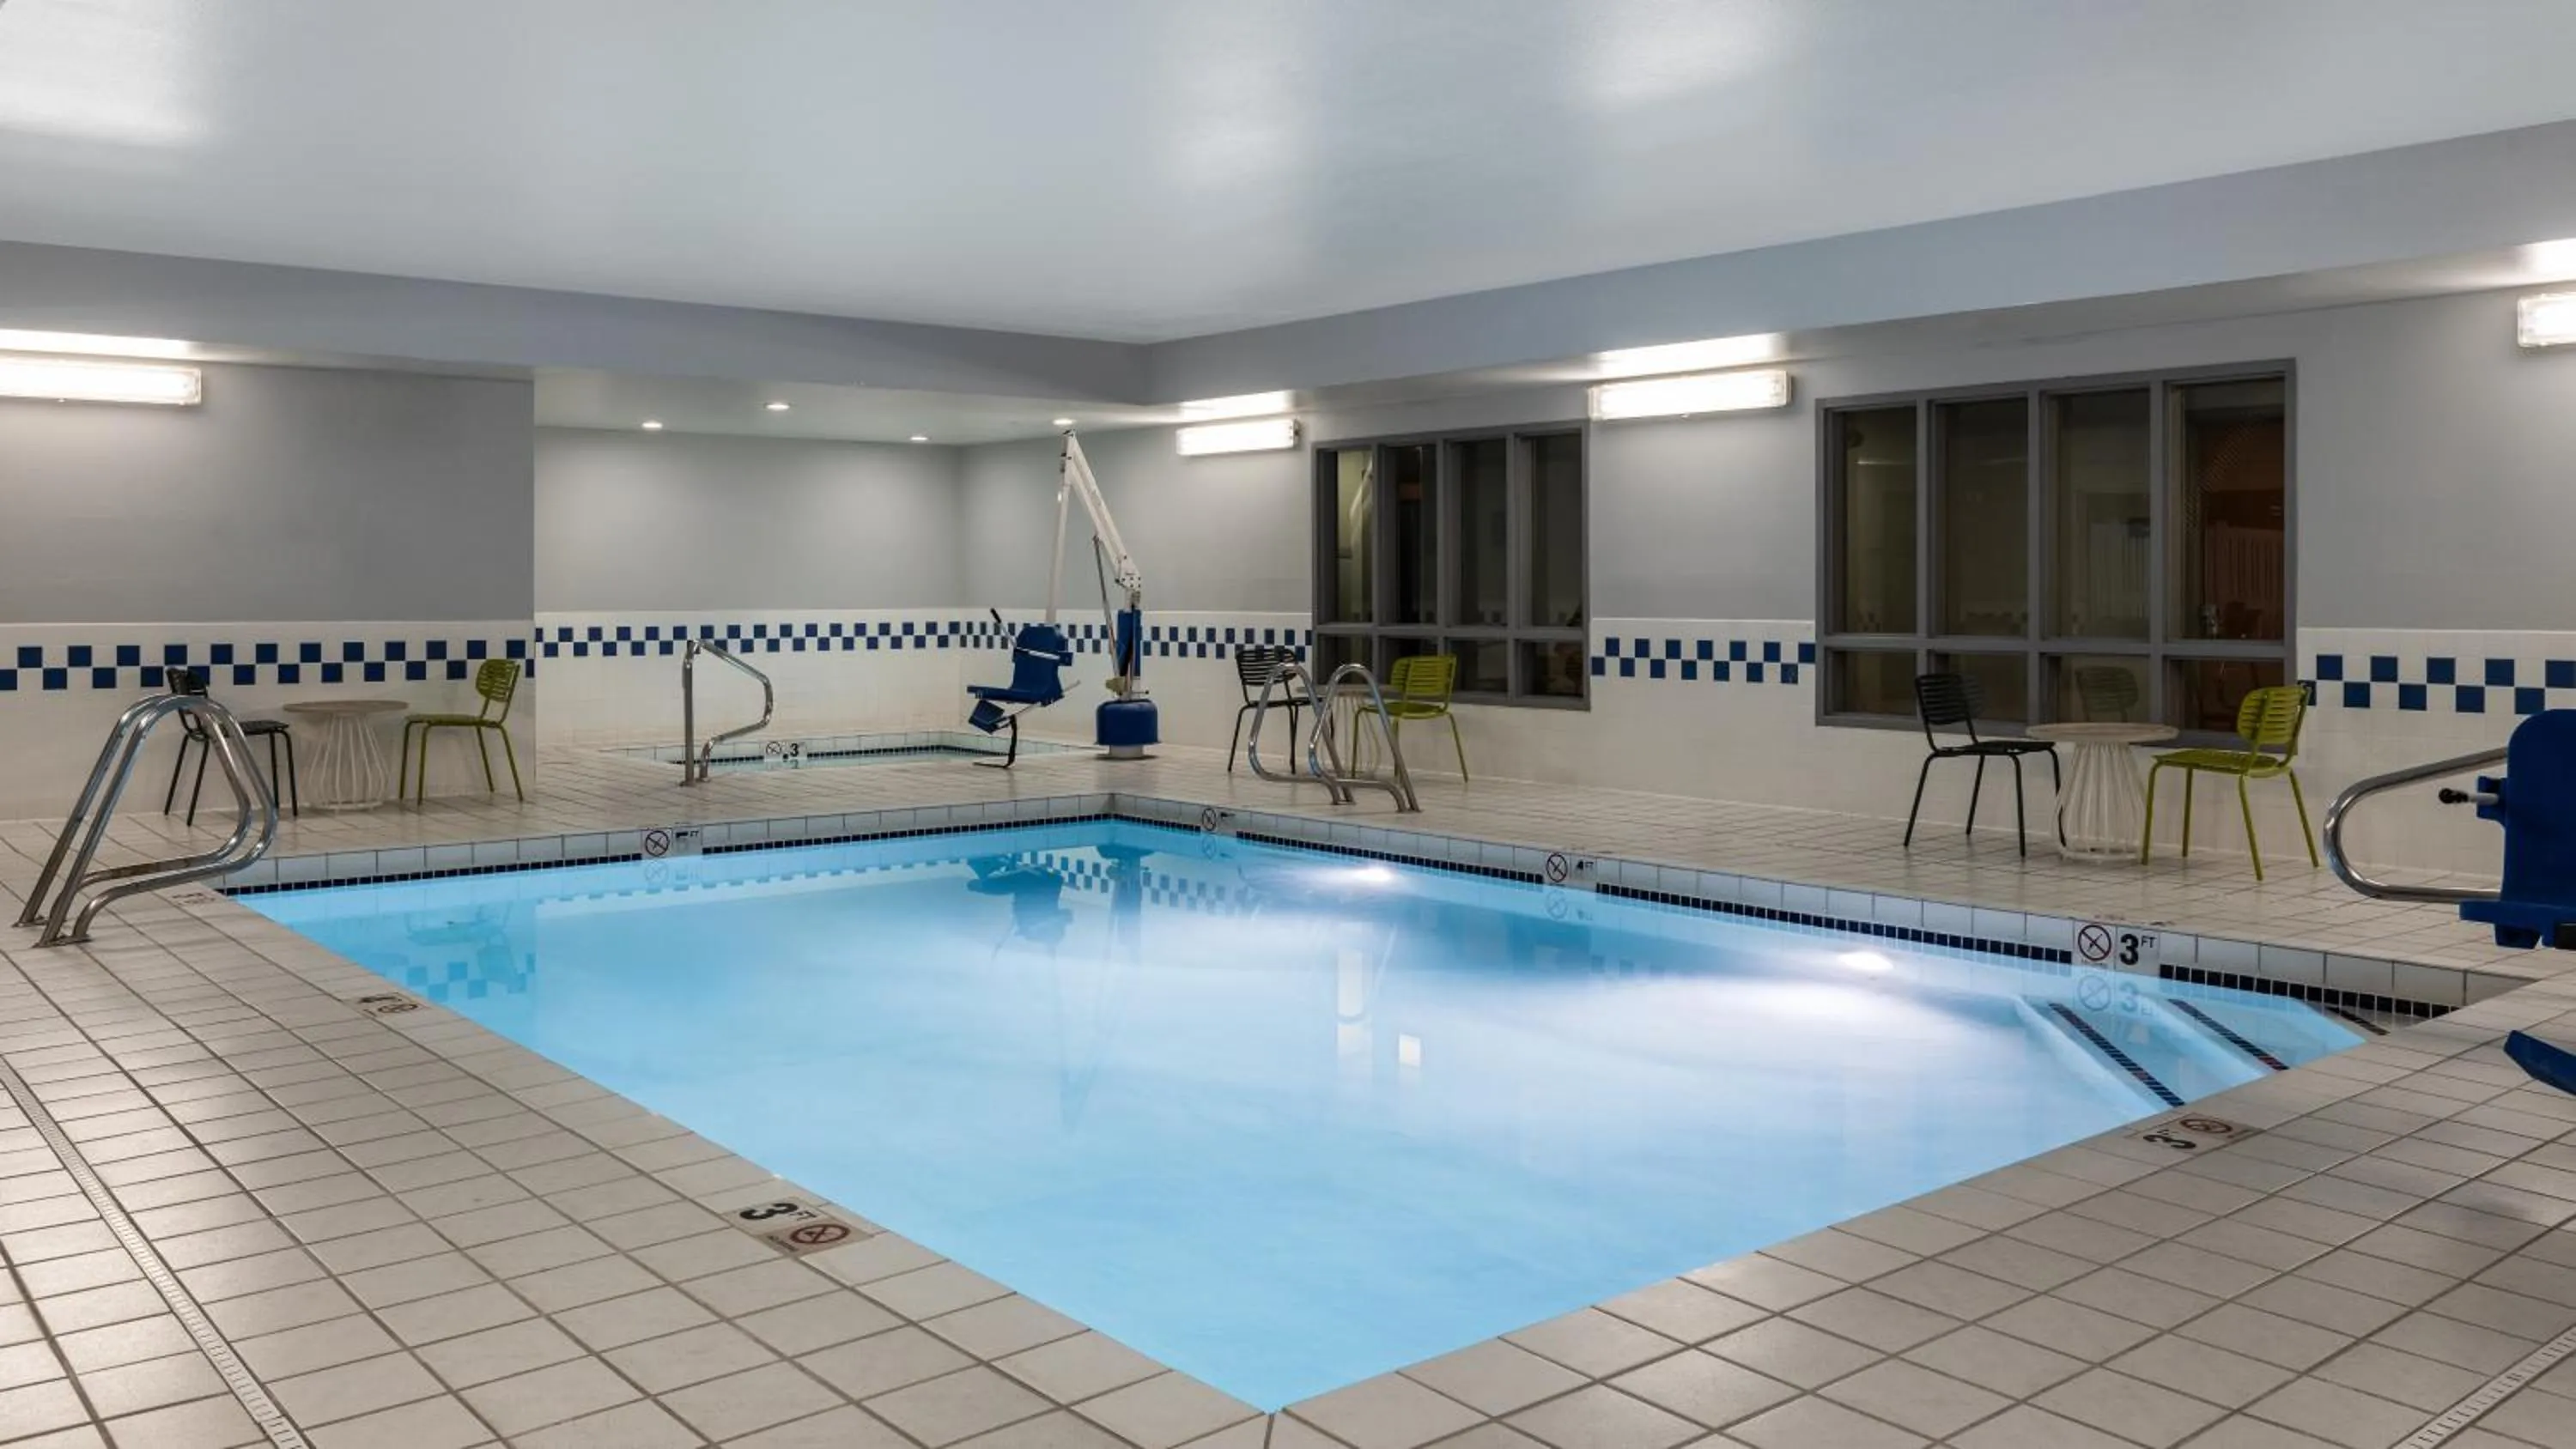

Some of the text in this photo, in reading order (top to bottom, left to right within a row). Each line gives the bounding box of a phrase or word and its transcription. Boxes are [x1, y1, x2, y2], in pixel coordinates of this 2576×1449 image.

[2119, 933, 2139, 966] 3
[2141, 936, 2156, 949] FT
[2143, 1135, 2196, 1149] 3
[739, 1203, 799, 1221] 3
